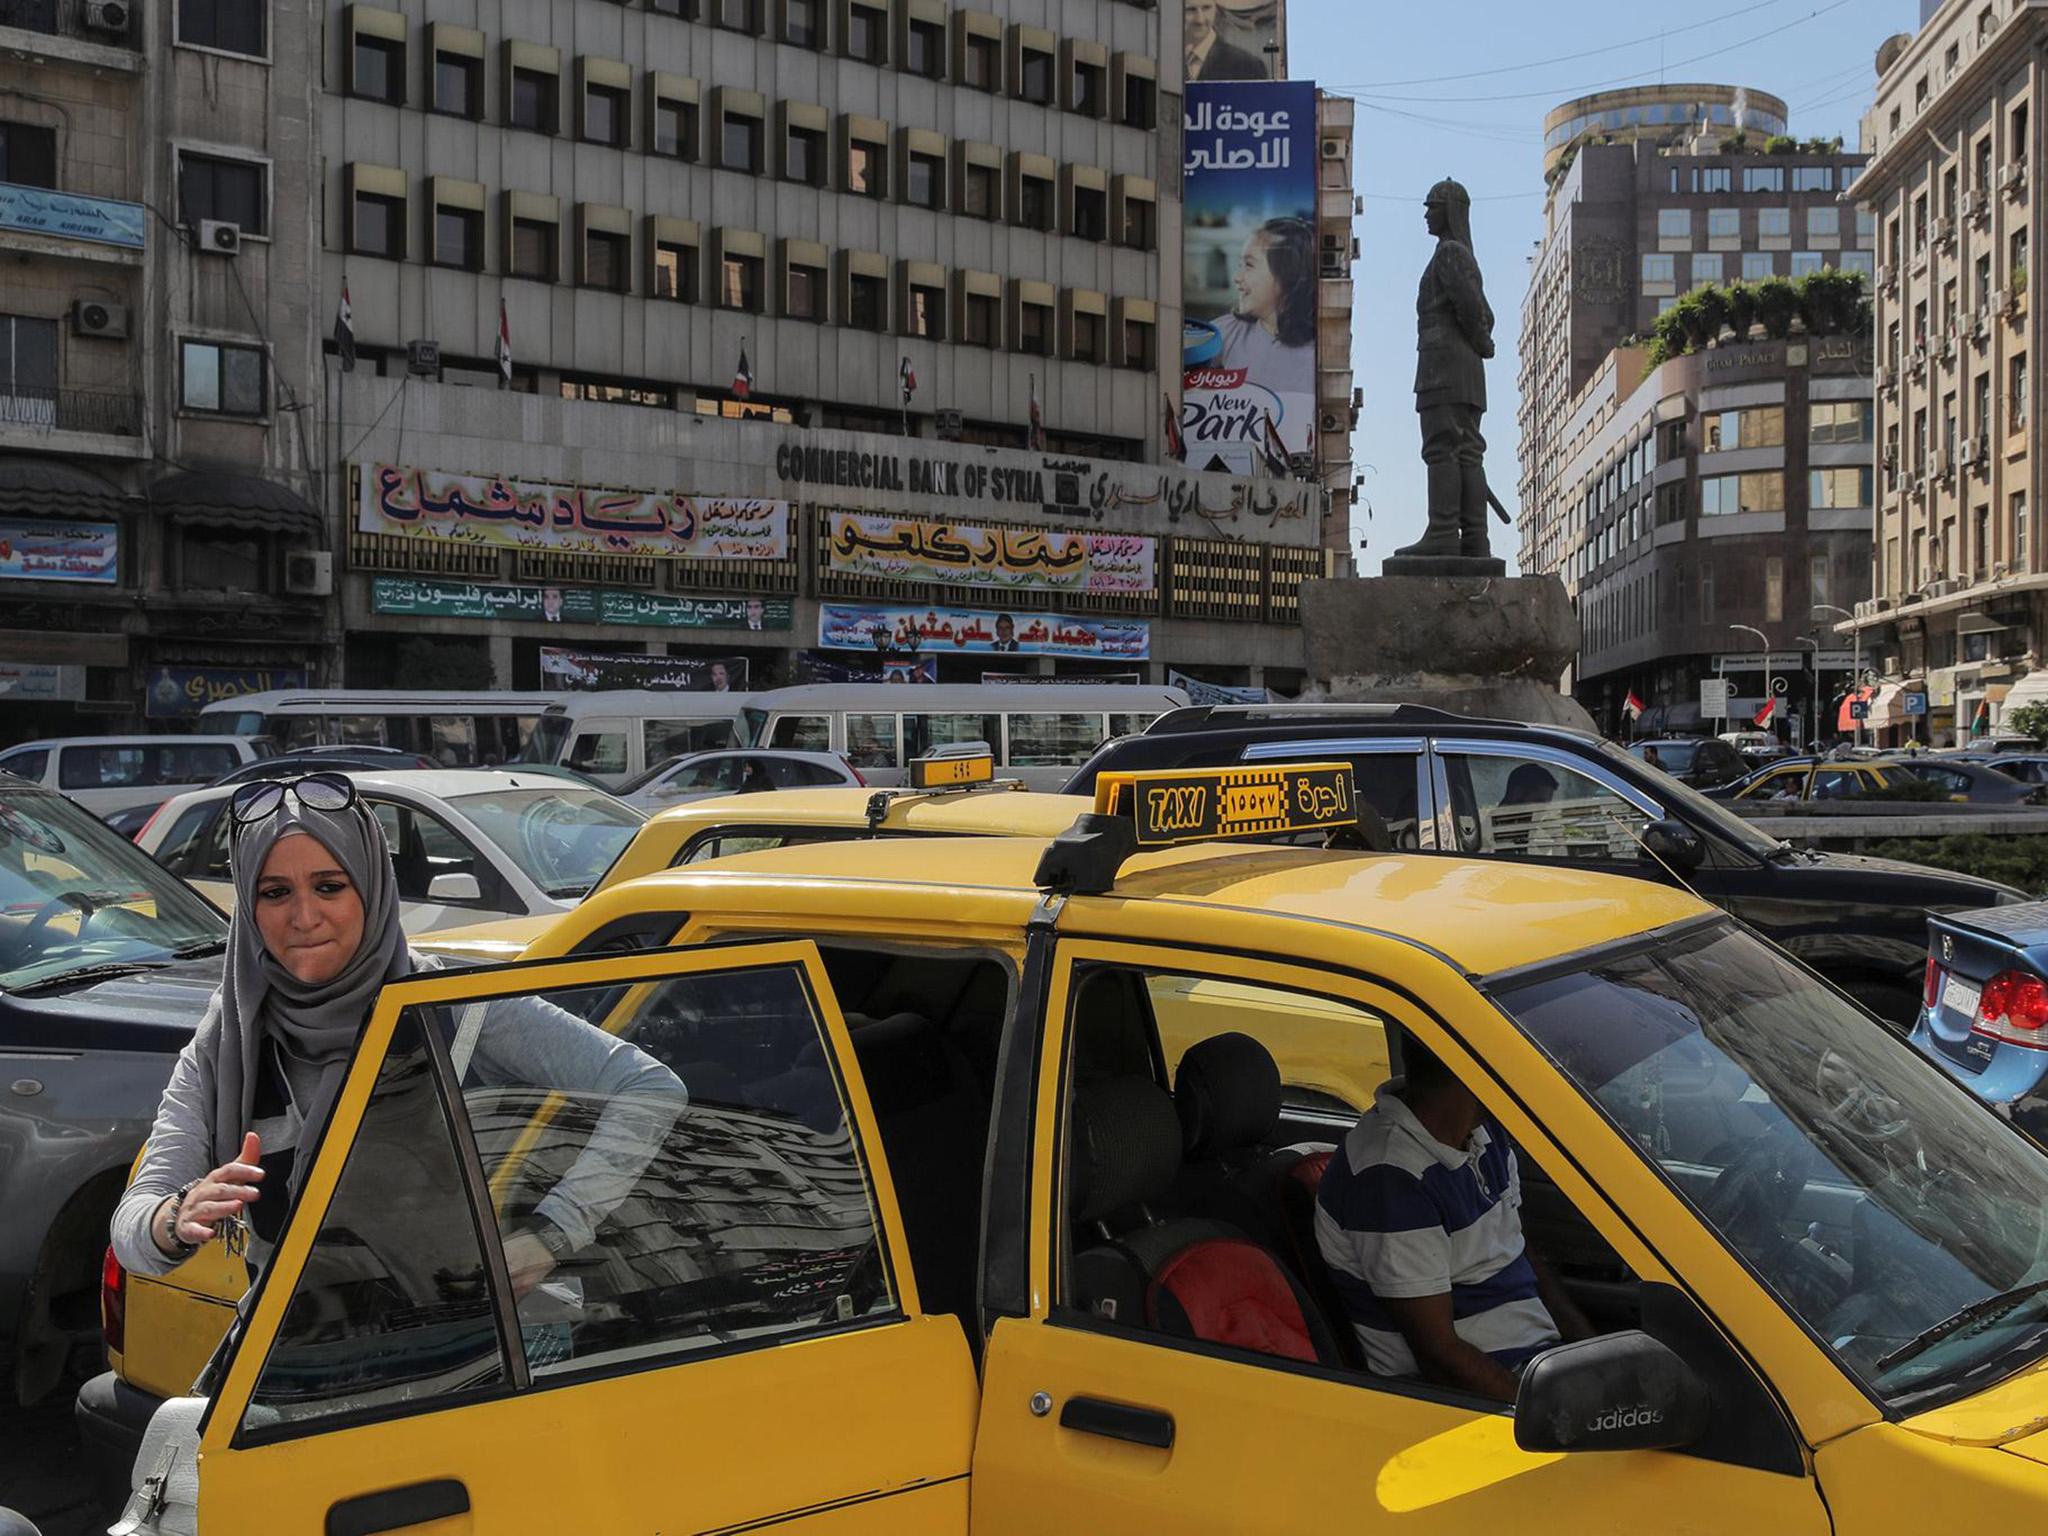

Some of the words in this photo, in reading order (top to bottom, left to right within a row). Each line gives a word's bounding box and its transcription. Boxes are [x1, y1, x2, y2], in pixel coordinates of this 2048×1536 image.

[1216, 104, 1290, 138] عودة
[1188, 371, 1238, 389] نيوبارك
[1208, 394, 1250, 412] New
[1184, 402, 1265, 443] Park
[776, 443, 904, 493] COMMERCIAL
[908, 457, 960, 498] BANK
[964, 463, 988, 500] OF
[991, 465, 1045, 506] SYRIA
[1088, 472, 1169, 523] السوري
[1167, 478, 1252, 524] التجاري
[1253, 483, 1310, 529] المصرف
[974, 529, 1084, 569] عمار
[1052, 622, 1097, 646] محمد
[643, 672, 691, 688] المهندس
[1851, 705, 1861, 716] P
[1906, 696, 1918, 709] P
[1148, 786, 1207, 832] TAXI
[1297, 772, 1348, 820] أجرة
[1587, 1408, 1664, 1432] adidas
